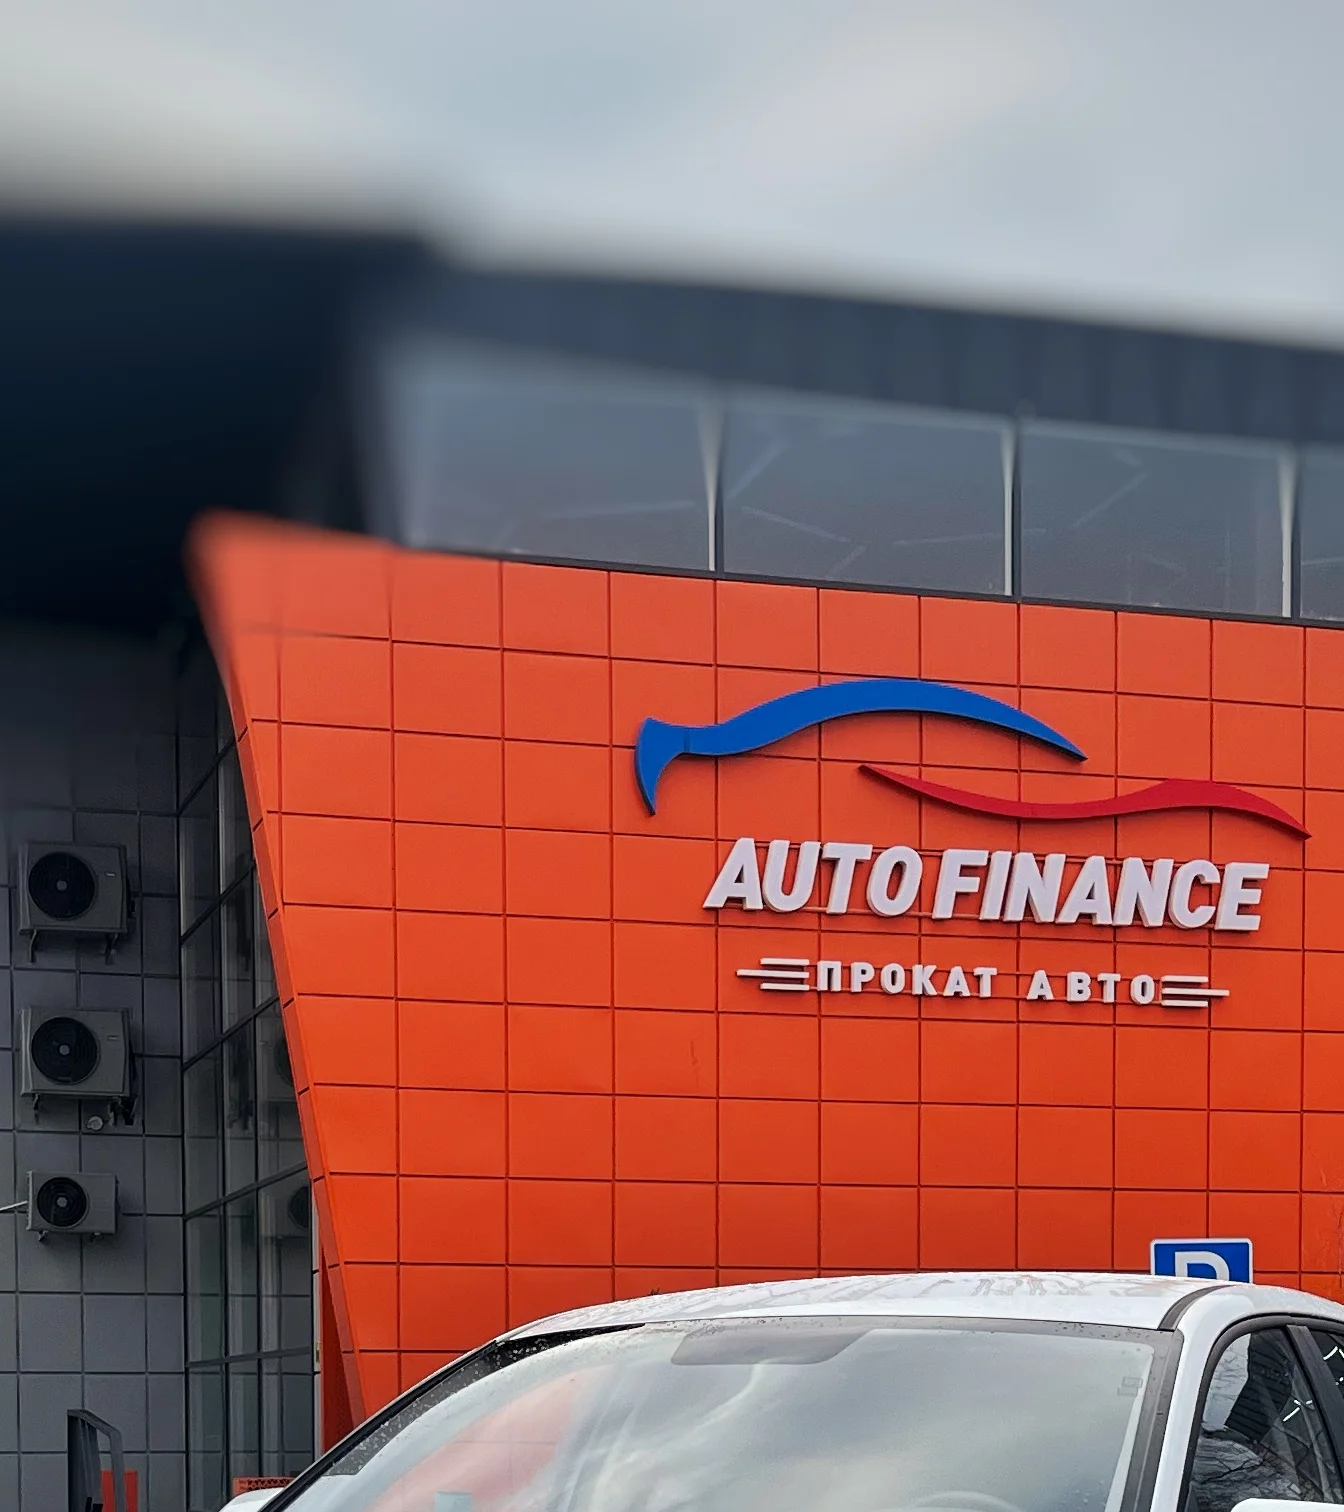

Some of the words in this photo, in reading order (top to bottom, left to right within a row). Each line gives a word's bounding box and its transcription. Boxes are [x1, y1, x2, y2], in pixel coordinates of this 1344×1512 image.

[703, 837, 923, 916] AUTO
[931, 848, 1269, 931] FINANCE
[816, 959, 997, 998] ПРОКАТ
[1027, 969, 1155, 1006] АВТО
